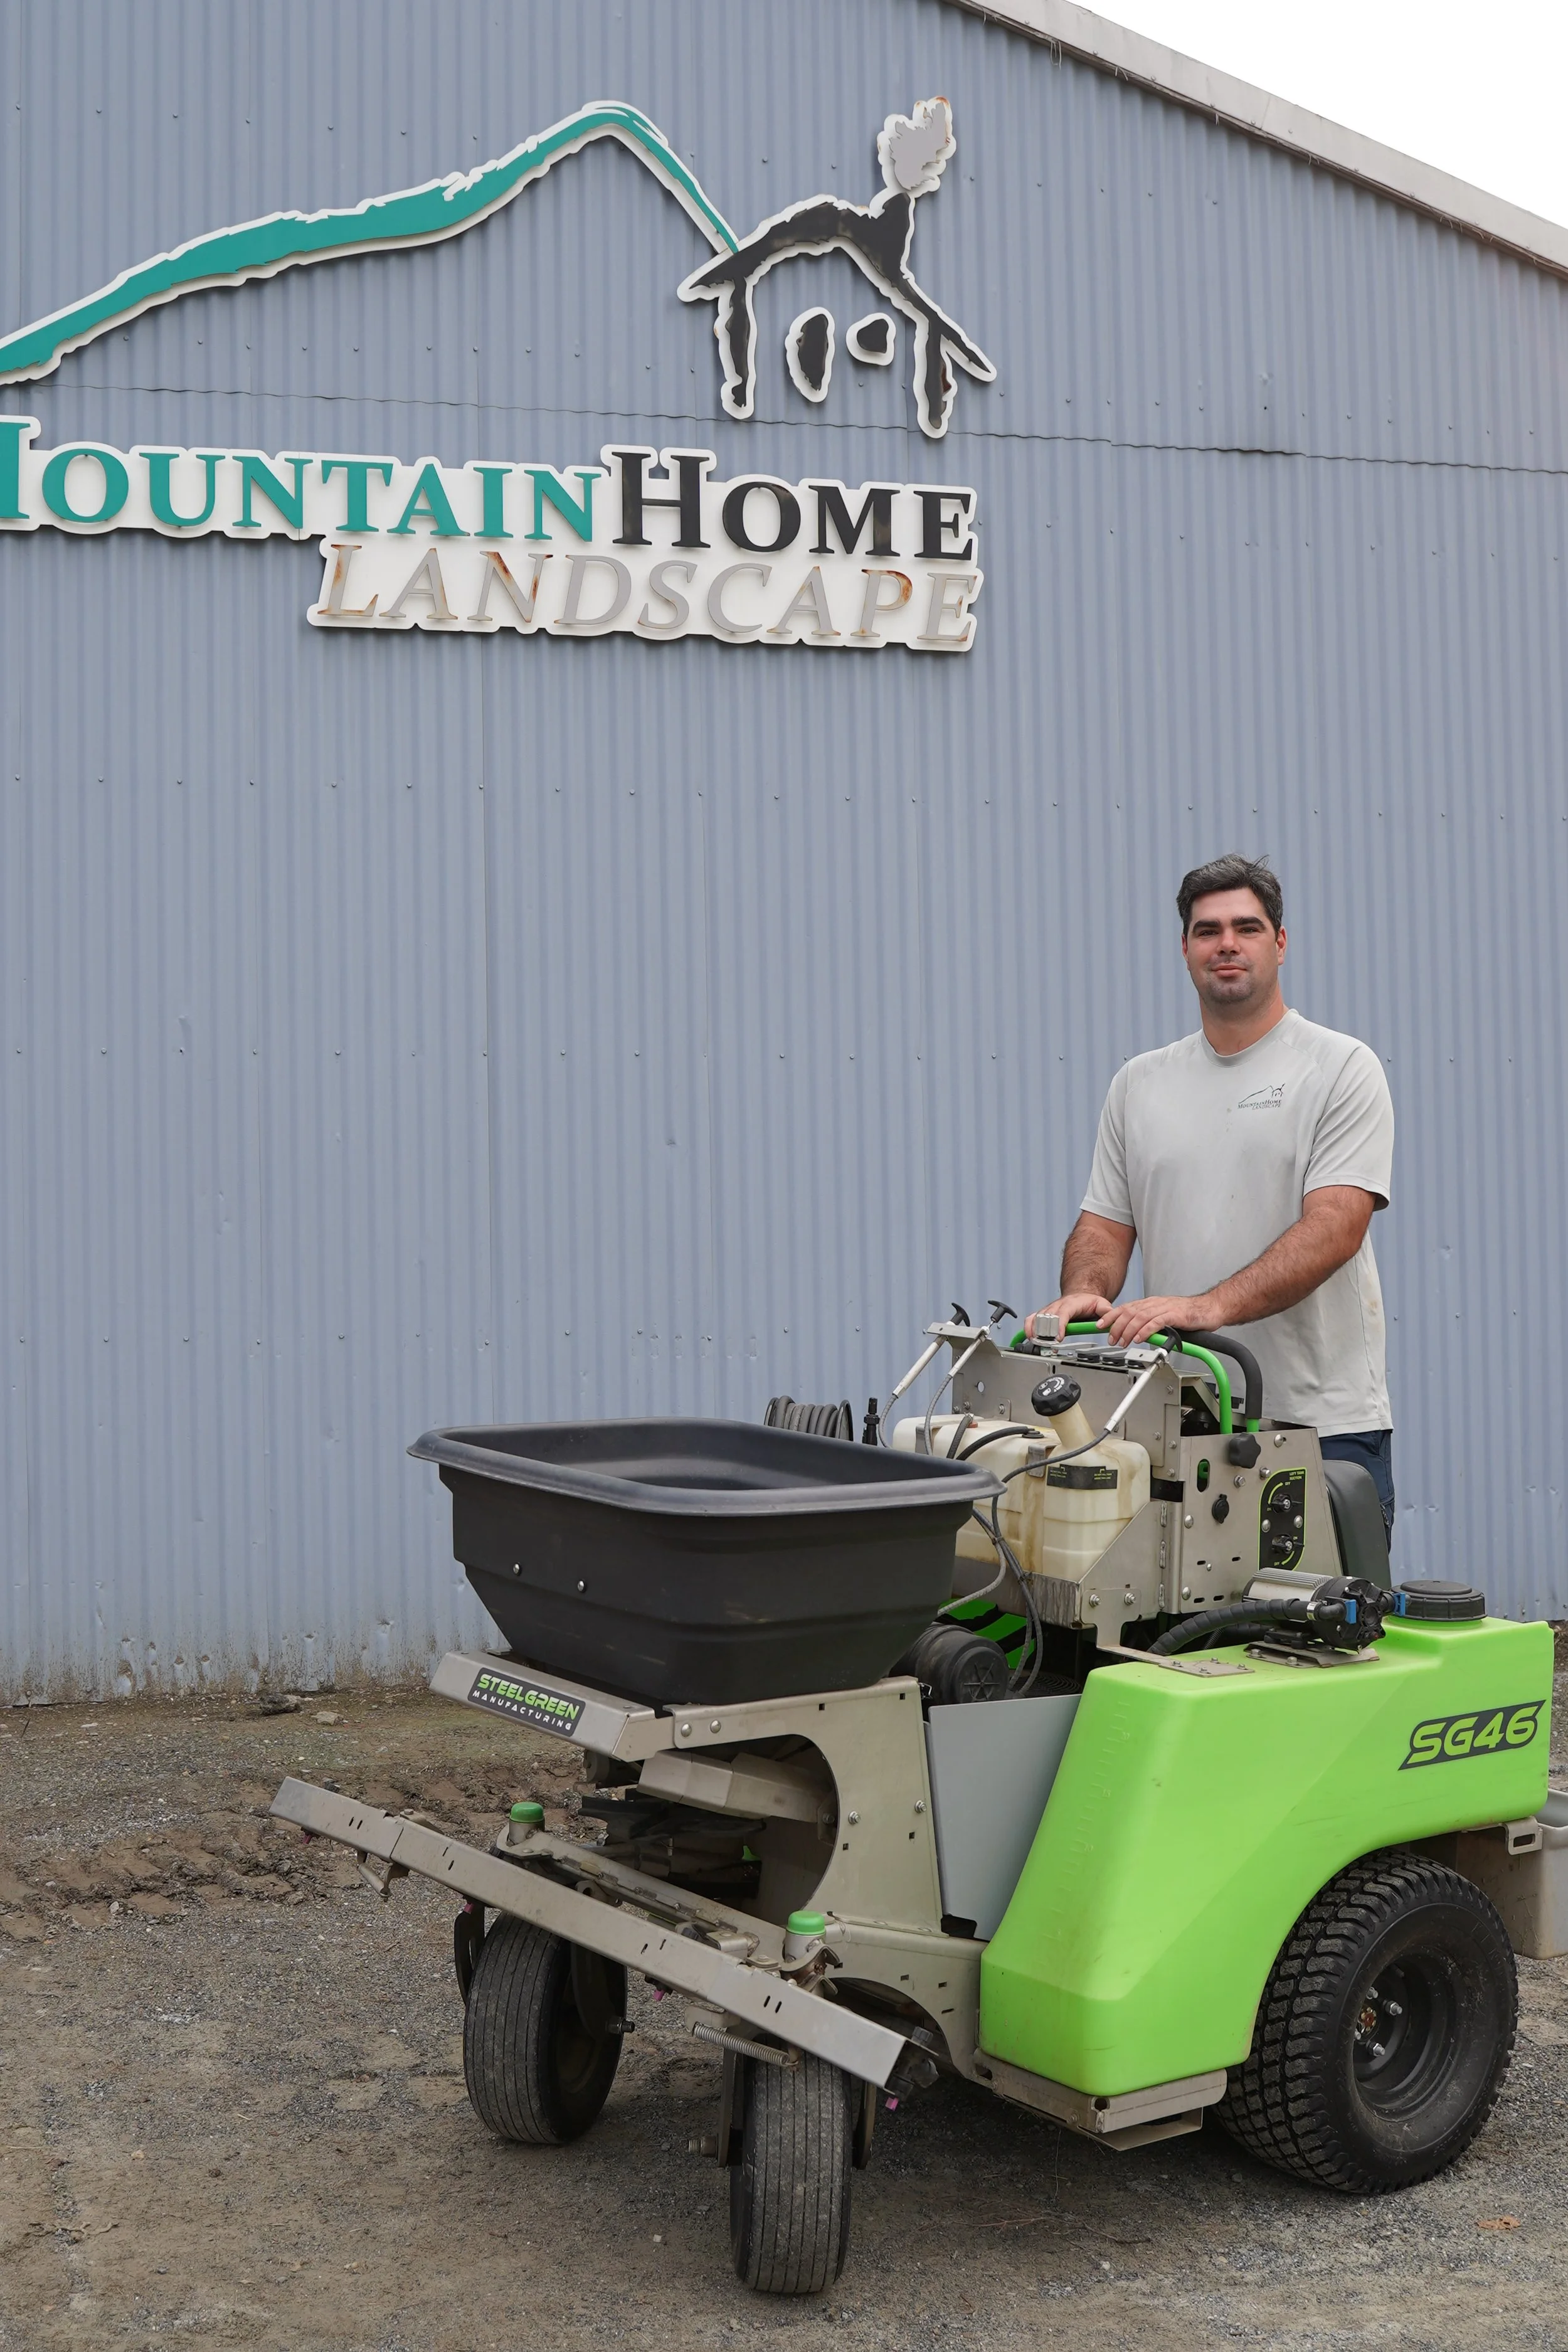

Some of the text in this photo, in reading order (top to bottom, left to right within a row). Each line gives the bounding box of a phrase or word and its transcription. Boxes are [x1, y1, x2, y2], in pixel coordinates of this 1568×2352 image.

[0, 421, 973, 561] OUNTAINHOME
[317, 544, 978, 642] LANDSCAPE
[472, 1690, 572, 1730] MANUFACTURING
[477, 1673, 580, 1720] STEELGREEN
[1406, 1705, 1539, 1764] SG46
